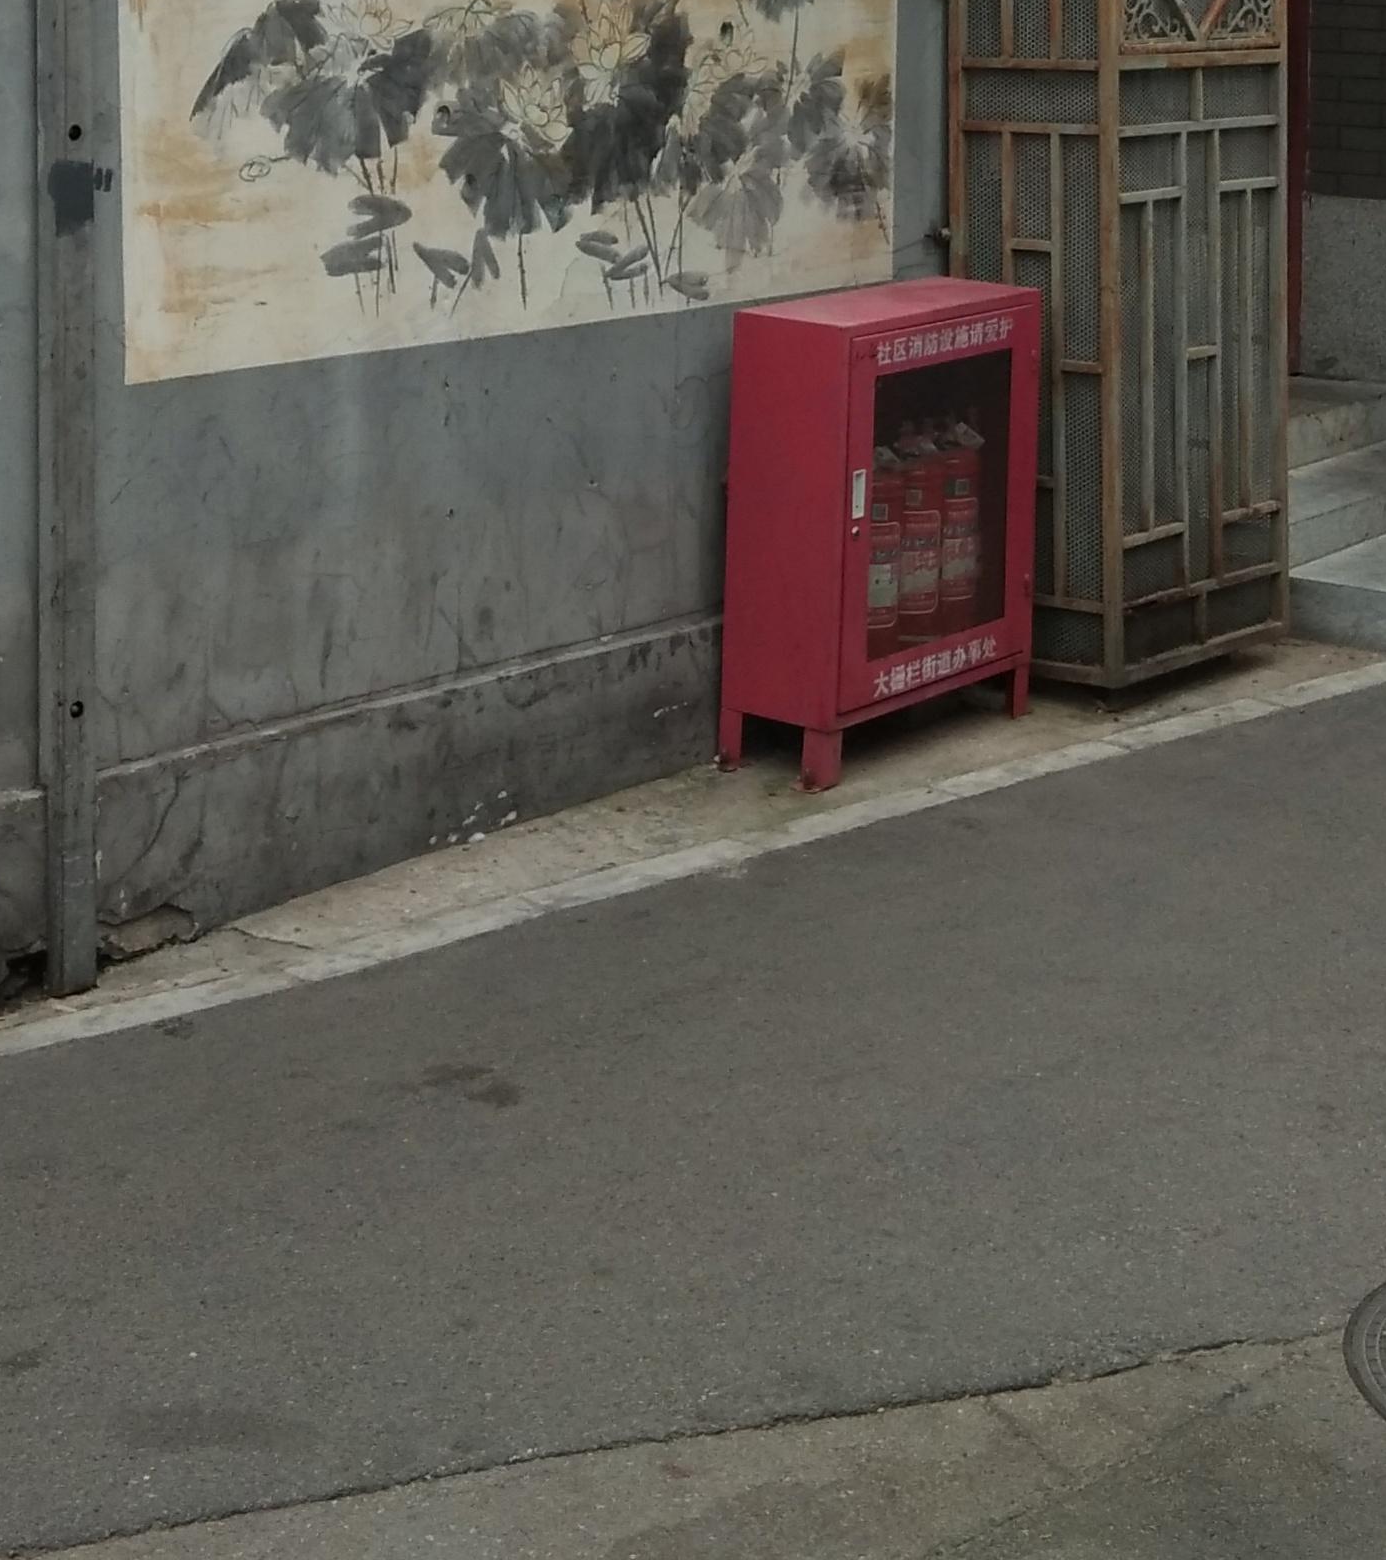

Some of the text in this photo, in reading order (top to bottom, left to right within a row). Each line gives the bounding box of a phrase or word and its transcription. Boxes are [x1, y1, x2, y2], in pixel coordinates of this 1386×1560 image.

[876, 317, 1013, 366] 社区消防设施请爱护
